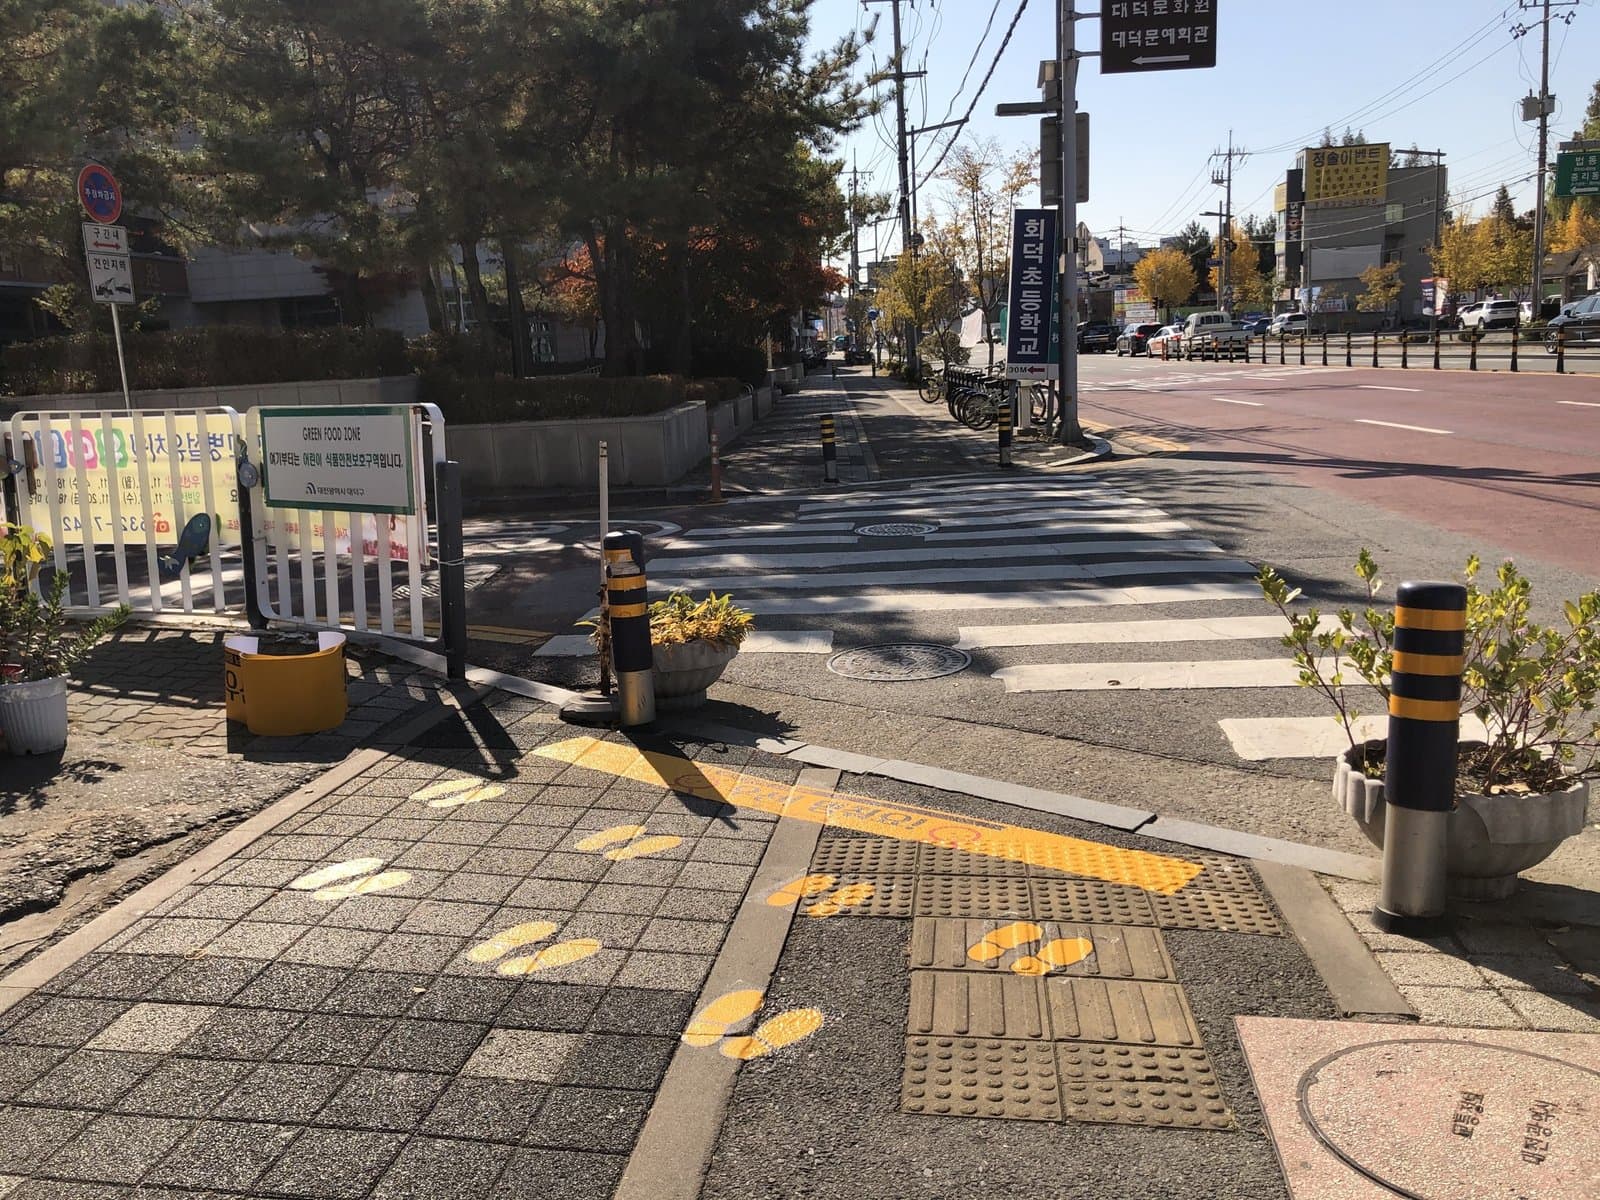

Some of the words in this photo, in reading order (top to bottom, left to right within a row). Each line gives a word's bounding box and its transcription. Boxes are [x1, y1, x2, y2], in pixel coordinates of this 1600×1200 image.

[1111, 0, 1209, 18] 대덕문화원
[1111, 25, 1209, 48] 대덕문예회관
[93, 257, 127, 271] 견인지역
[1016, 219, 1046, 355] 회덕초등학교
[302, 427, 322, 441] GREEN
[324, 427, 342, 441] FOOD
[344, 427, 361, 441] ZONE
[269, 452, 300, 466] 여기부터는
[303, 452, 322, 467] 어린이
[325, 452, 403, 469] 식품안전보호구역입니다.
[1520, 1099, 1559, 1165] 대전광역시
